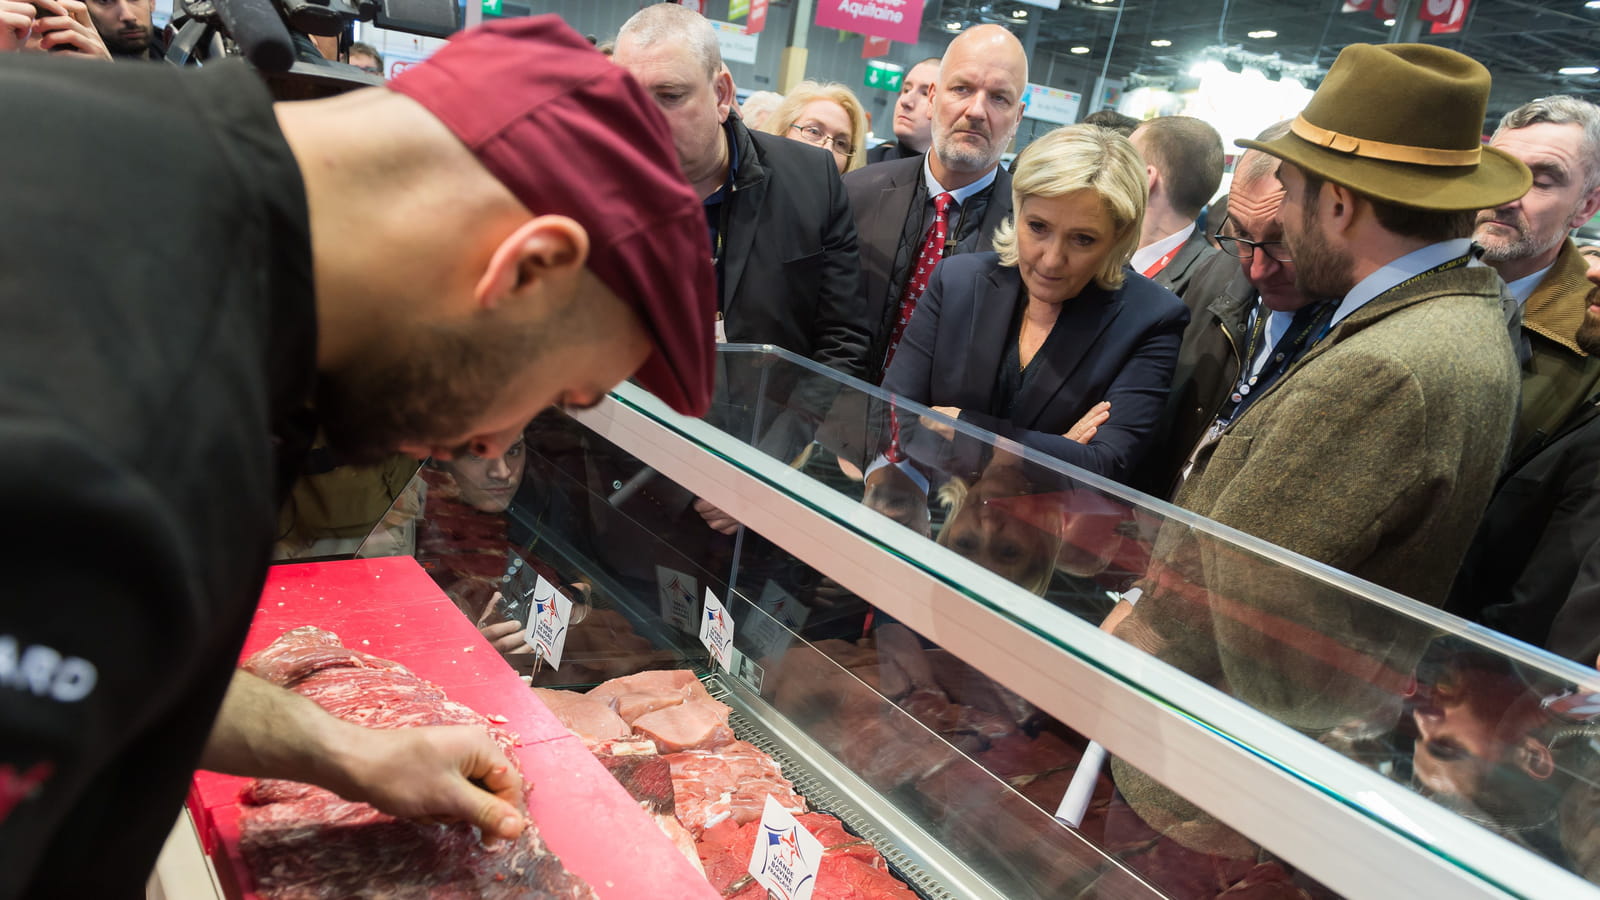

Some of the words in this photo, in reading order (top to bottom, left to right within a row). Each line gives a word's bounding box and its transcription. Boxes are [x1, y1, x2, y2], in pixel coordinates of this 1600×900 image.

[837, 0, 904, 24] Aquitaine
[770, 860, 793, 886] BOVINE
[773, 853, 795, 879] VIANDE
